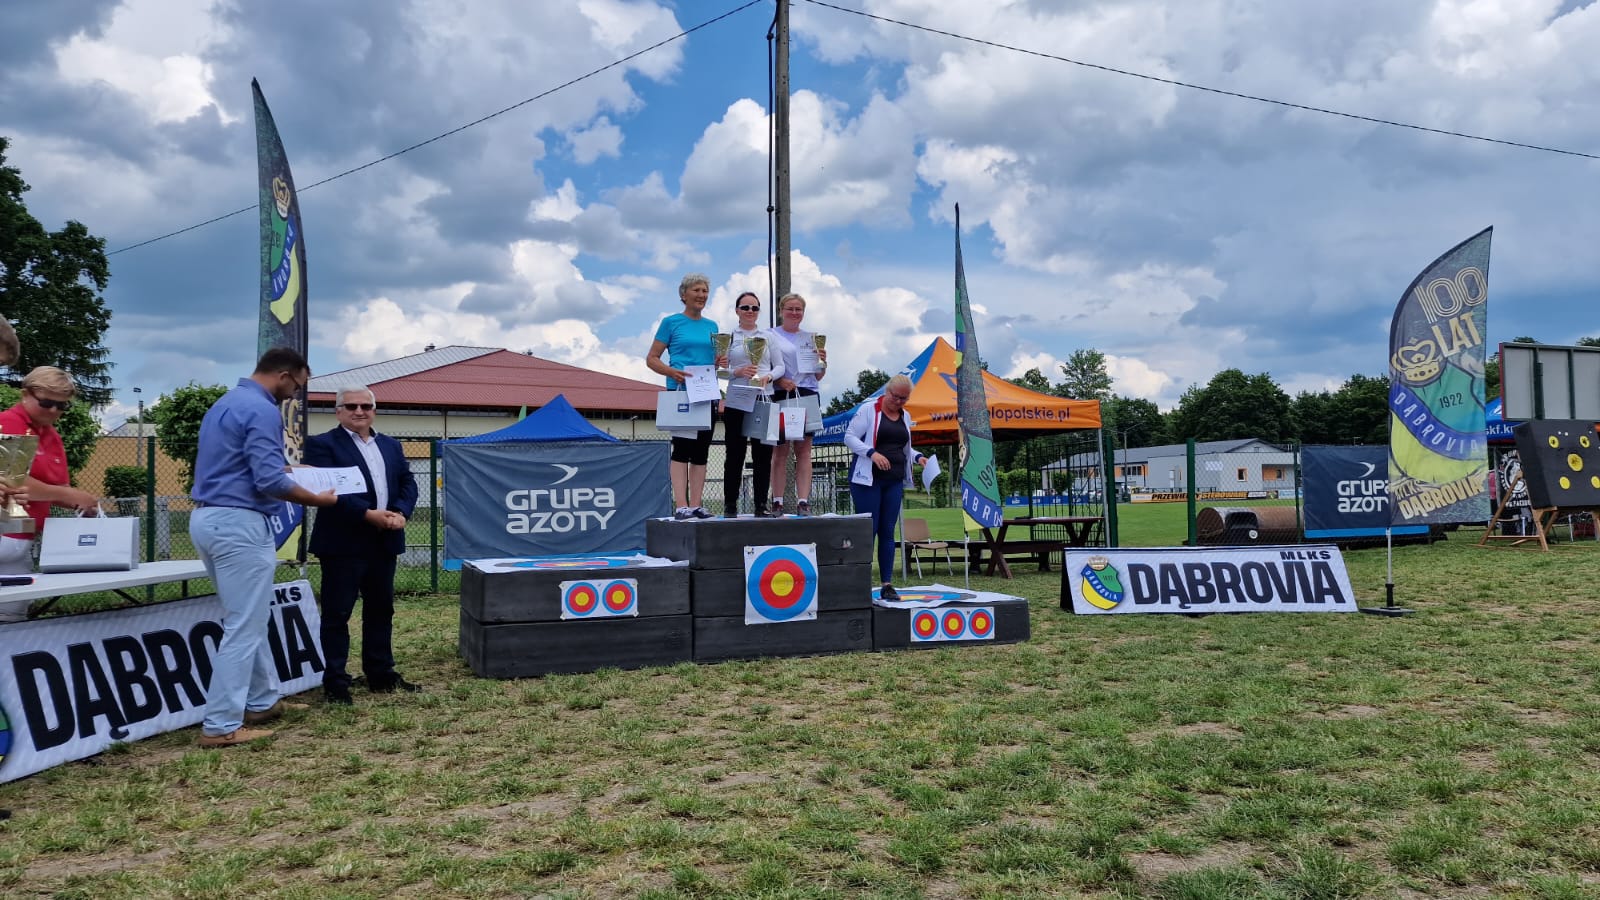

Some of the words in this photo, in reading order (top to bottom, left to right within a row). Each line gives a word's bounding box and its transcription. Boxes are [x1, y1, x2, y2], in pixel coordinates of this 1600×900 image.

[1414, 266, 1487, 324] 100
[1430, 310, 1482, 358] LAT
[1394, 392, 1478, 454] DABROVIA
[1440, 392, 1464, 409] 1922
[1397, 473, 1485, 521] DĄBROVIA
[1279, 550, 1331, 560] MLKS
[269, 586, 302, 606] KS
[1127, 561, 1346, 609] DĄBROVIA
[11, 603, 326, 752] DĄBROIA
